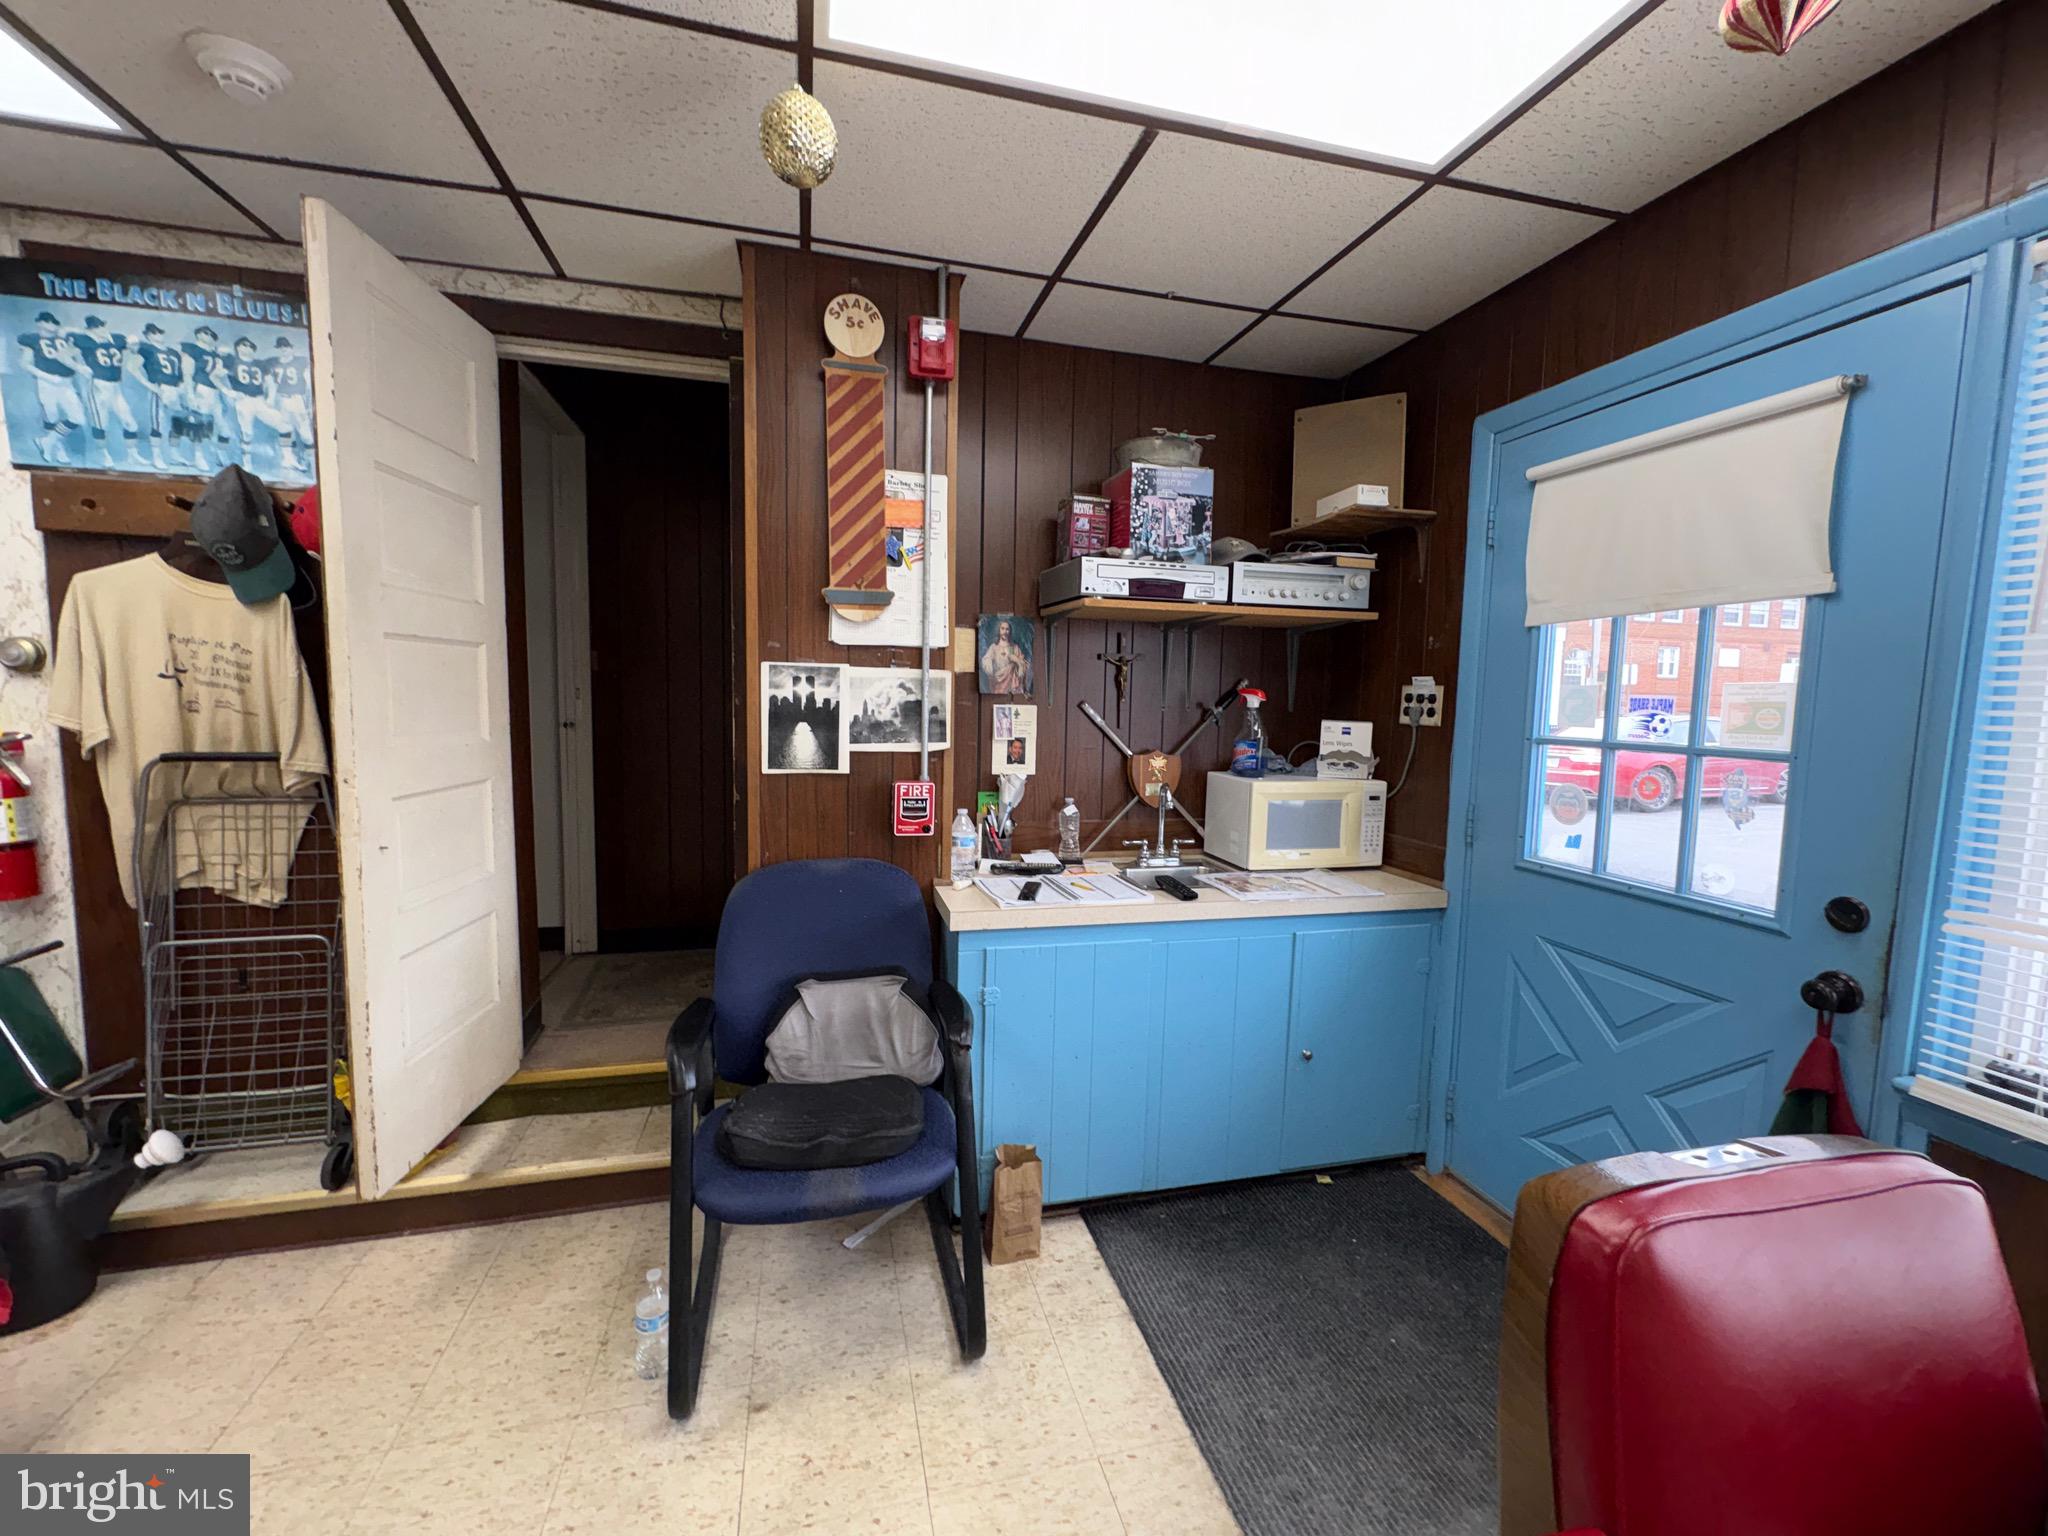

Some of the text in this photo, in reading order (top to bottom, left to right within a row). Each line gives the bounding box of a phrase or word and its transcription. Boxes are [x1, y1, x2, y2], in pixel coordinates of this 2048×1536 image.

[95, 278, 180, 310] BLACK
[216, 292, 292, 324] BLUES
[828, 297, 880, 324] SHAVE
[237, 363, 263, 386] 63
[275, 367, 298, 385] 79
[900, 785, 930, 797] FIRE
